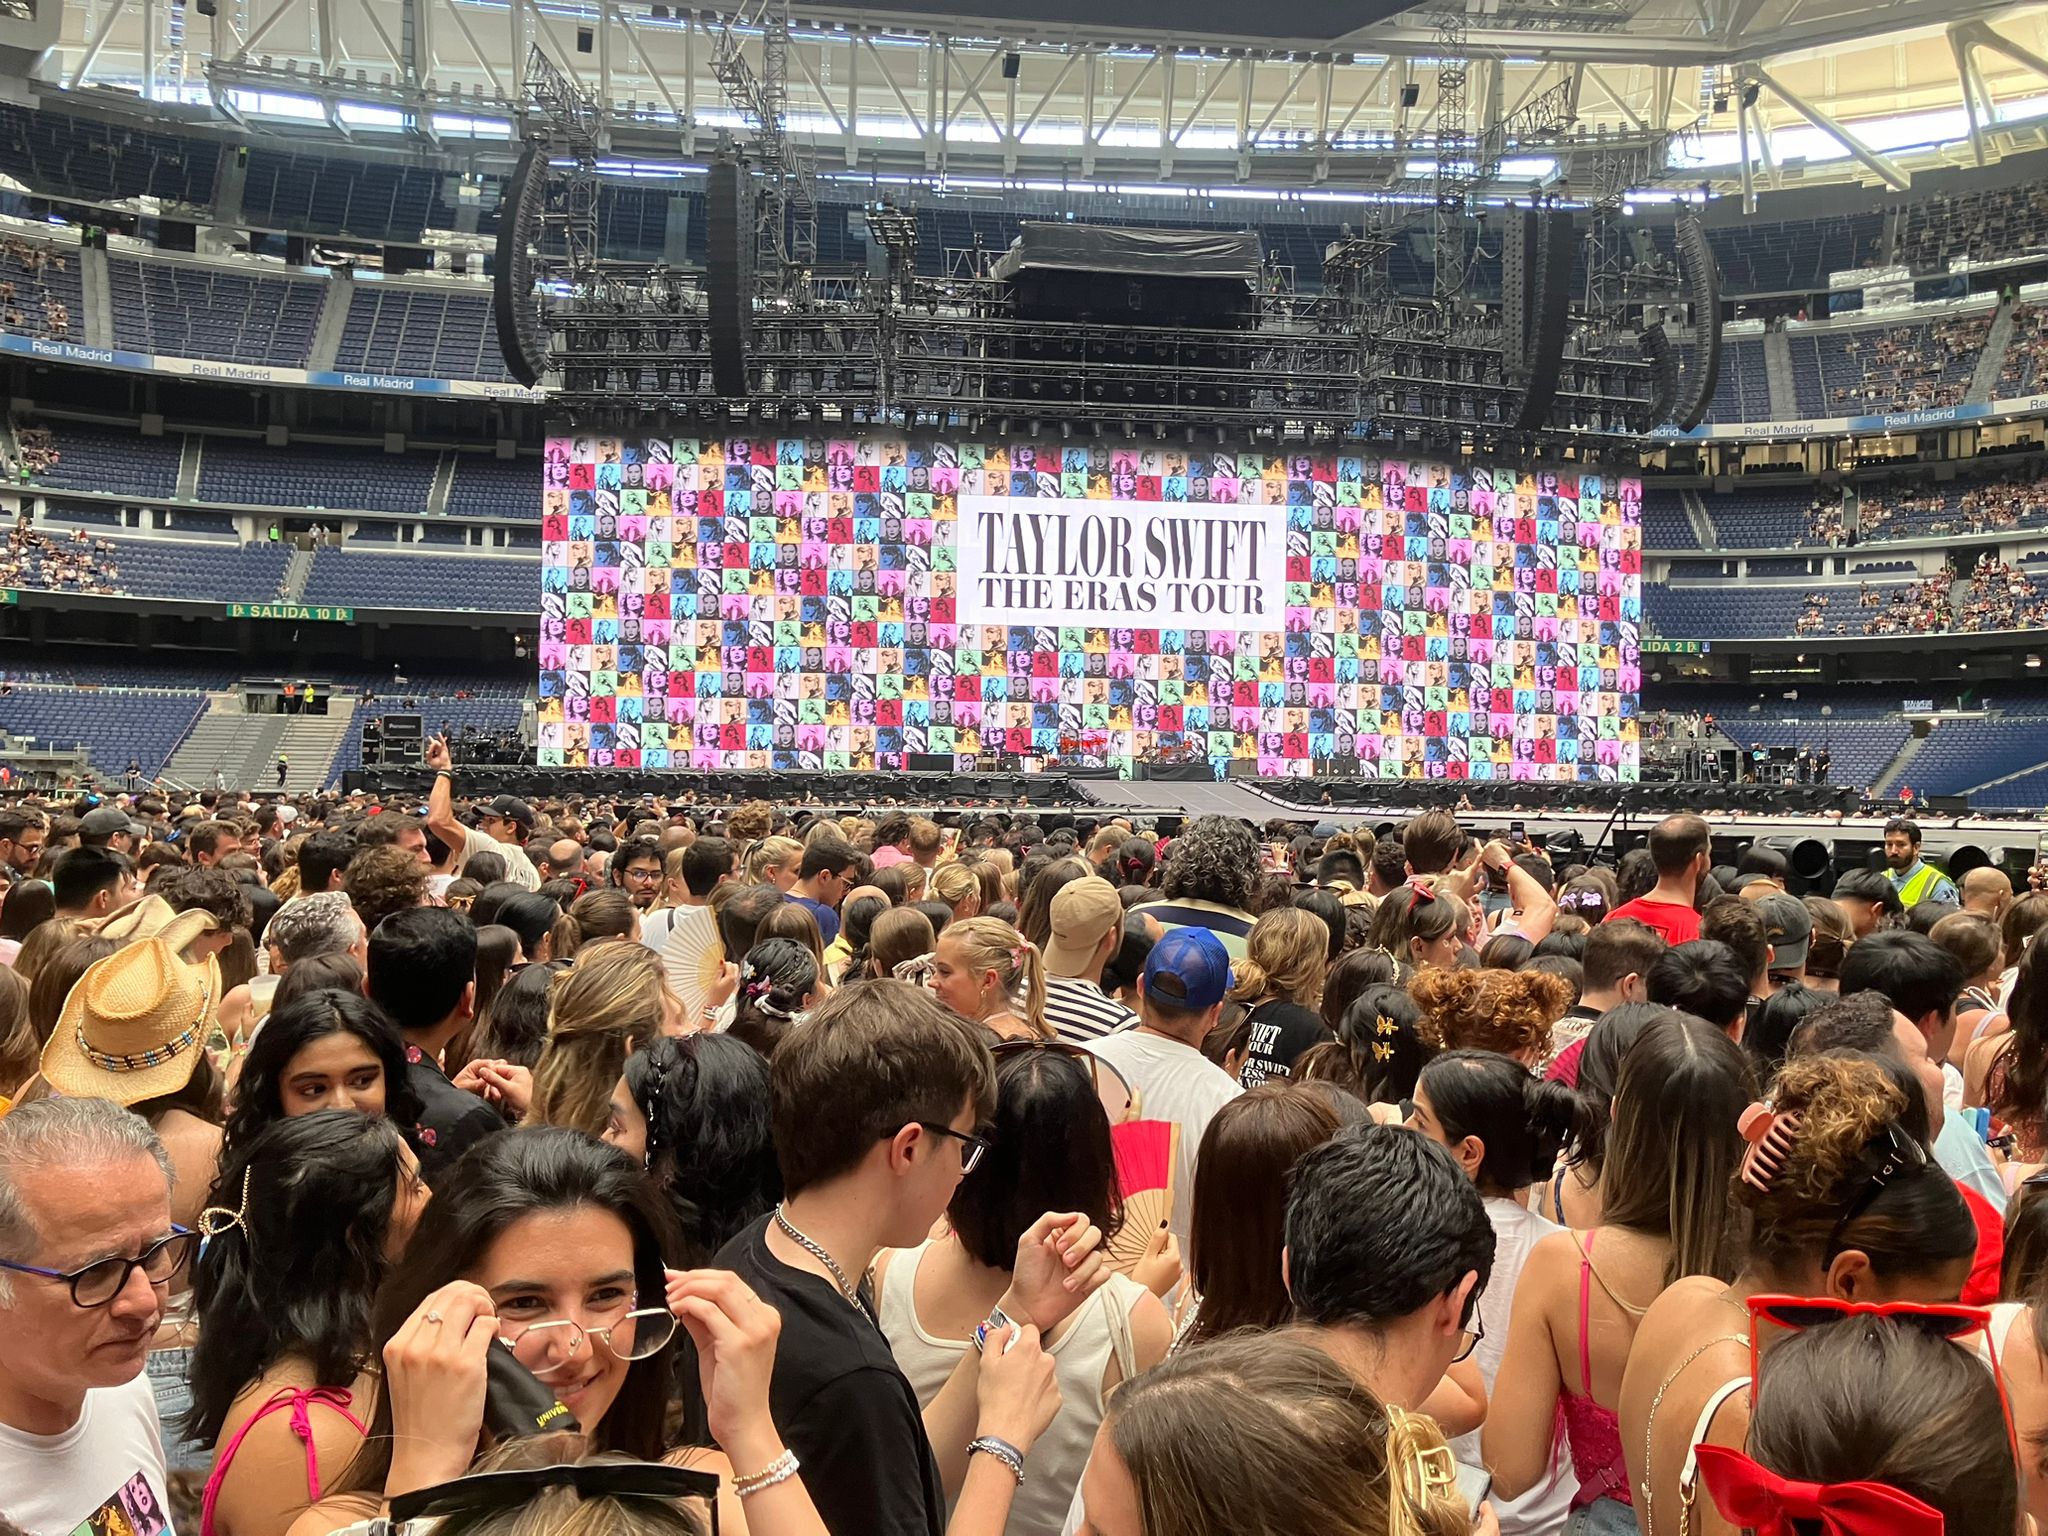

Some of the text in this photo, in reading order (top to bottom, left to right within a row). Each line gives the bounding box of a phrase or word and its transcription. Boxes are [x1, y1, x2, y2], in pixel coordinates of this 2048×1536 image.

[32, 341, 112, 362] Real Madrid
[192, 364, 271, 380] Real Madrid
[343, 375, 414, 390] Real Madrid
[484, 387, 548, 399] Real Madr
[2030, 400, 2048, 410] Re
[1884, 408, 1955, 426] Real Madrid
[1651, 427, 1680, 437] adrid
[1744, 423, 1814, 436] Real Madrid
[977, 512, 1267, 581] TAYLOR SWIFT
[977, 577, 1265, 615] THE ERAS TOUR
[250, 605, 330, 620] SALIDA 10
[1675, 641, 1683, 652] 2
[1256, 1059, 1291, 1077] SWIFT
